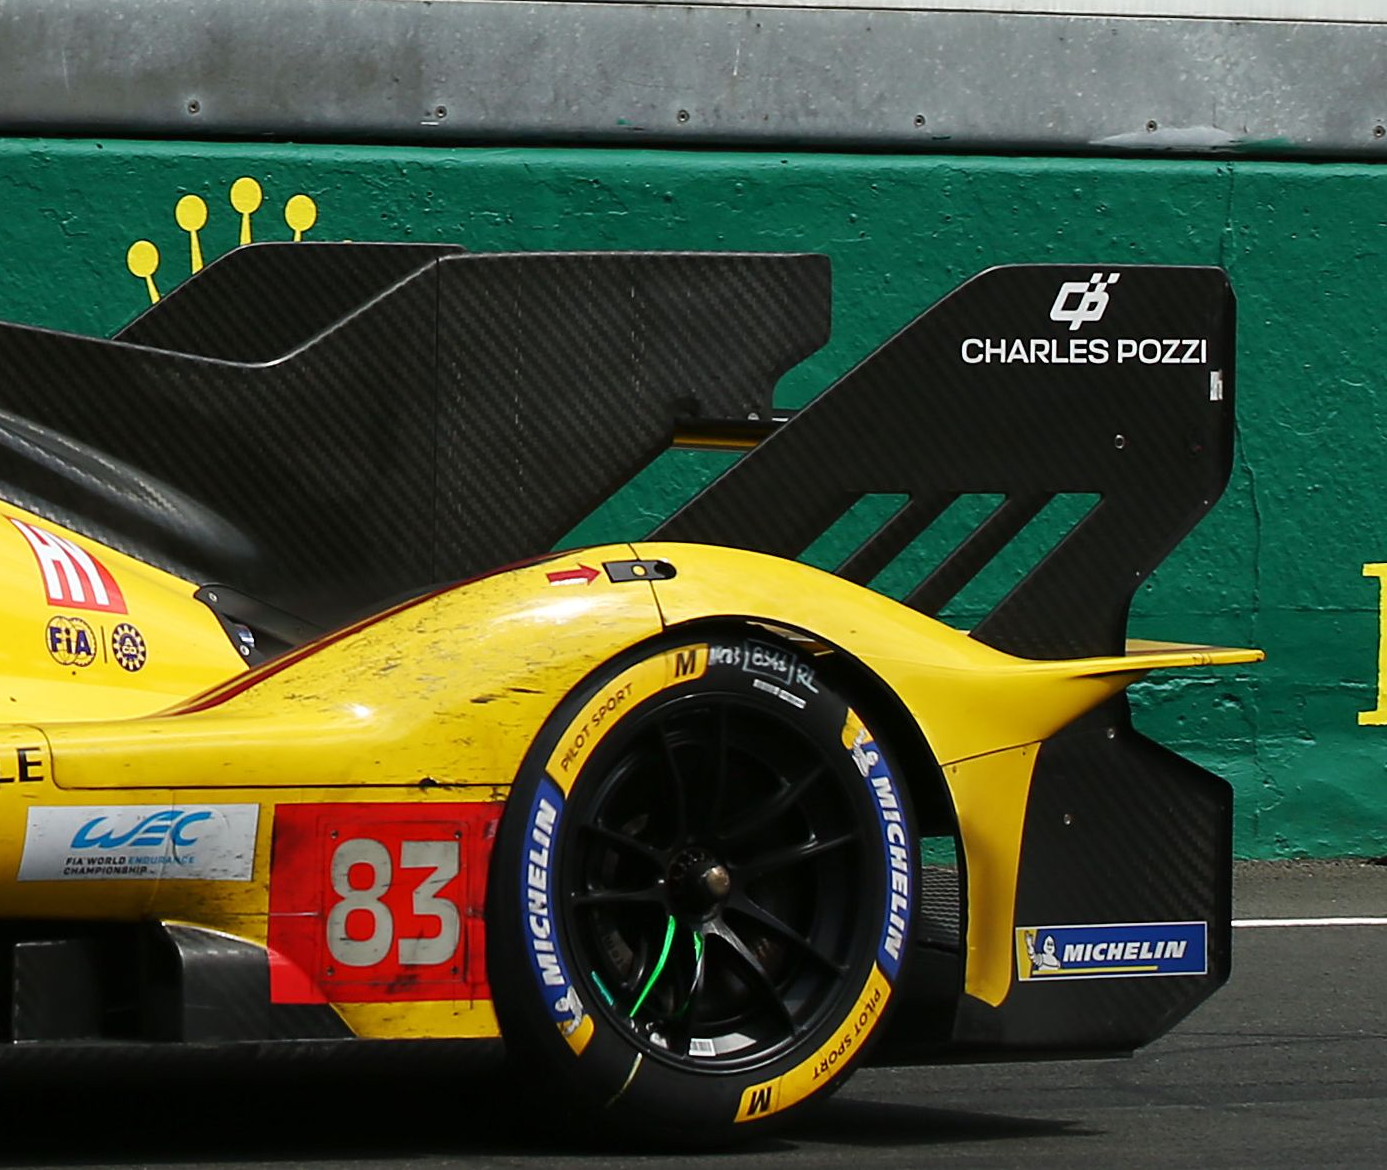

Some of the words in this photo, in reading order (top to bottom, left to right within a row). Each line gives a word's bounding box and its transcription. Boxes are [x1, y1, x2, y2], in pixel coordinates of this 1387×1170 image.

[961, 338, 1109, 364] CHARLES
[1117, 338, 1207, 364] POZZI
[673, 652, 697, 678] M
[560, 728, 592, 772] PILOT
[590, 682, 635, 724] SPORT
[69, 809, 213, 849] WEC
[63, 865, 148, 876] CHAMPIONSHIP
[65, 856, 84, 866] FIA
[86, 856, 126, 866] WORLD
[128, 855, 196, 865] ENDURANCE
[870, 775, 909, 961] MICHELIN
[326, 837, 460, 967] 83
[526, 798, 564, 986] MICHELIN
[1062, 940, 1188, 963] MICHELIN
[852, 987, 882, 1035] PILOT
[810, 1033, 854, 1082] SPORT
[746, 1085, 773, 1117] M
